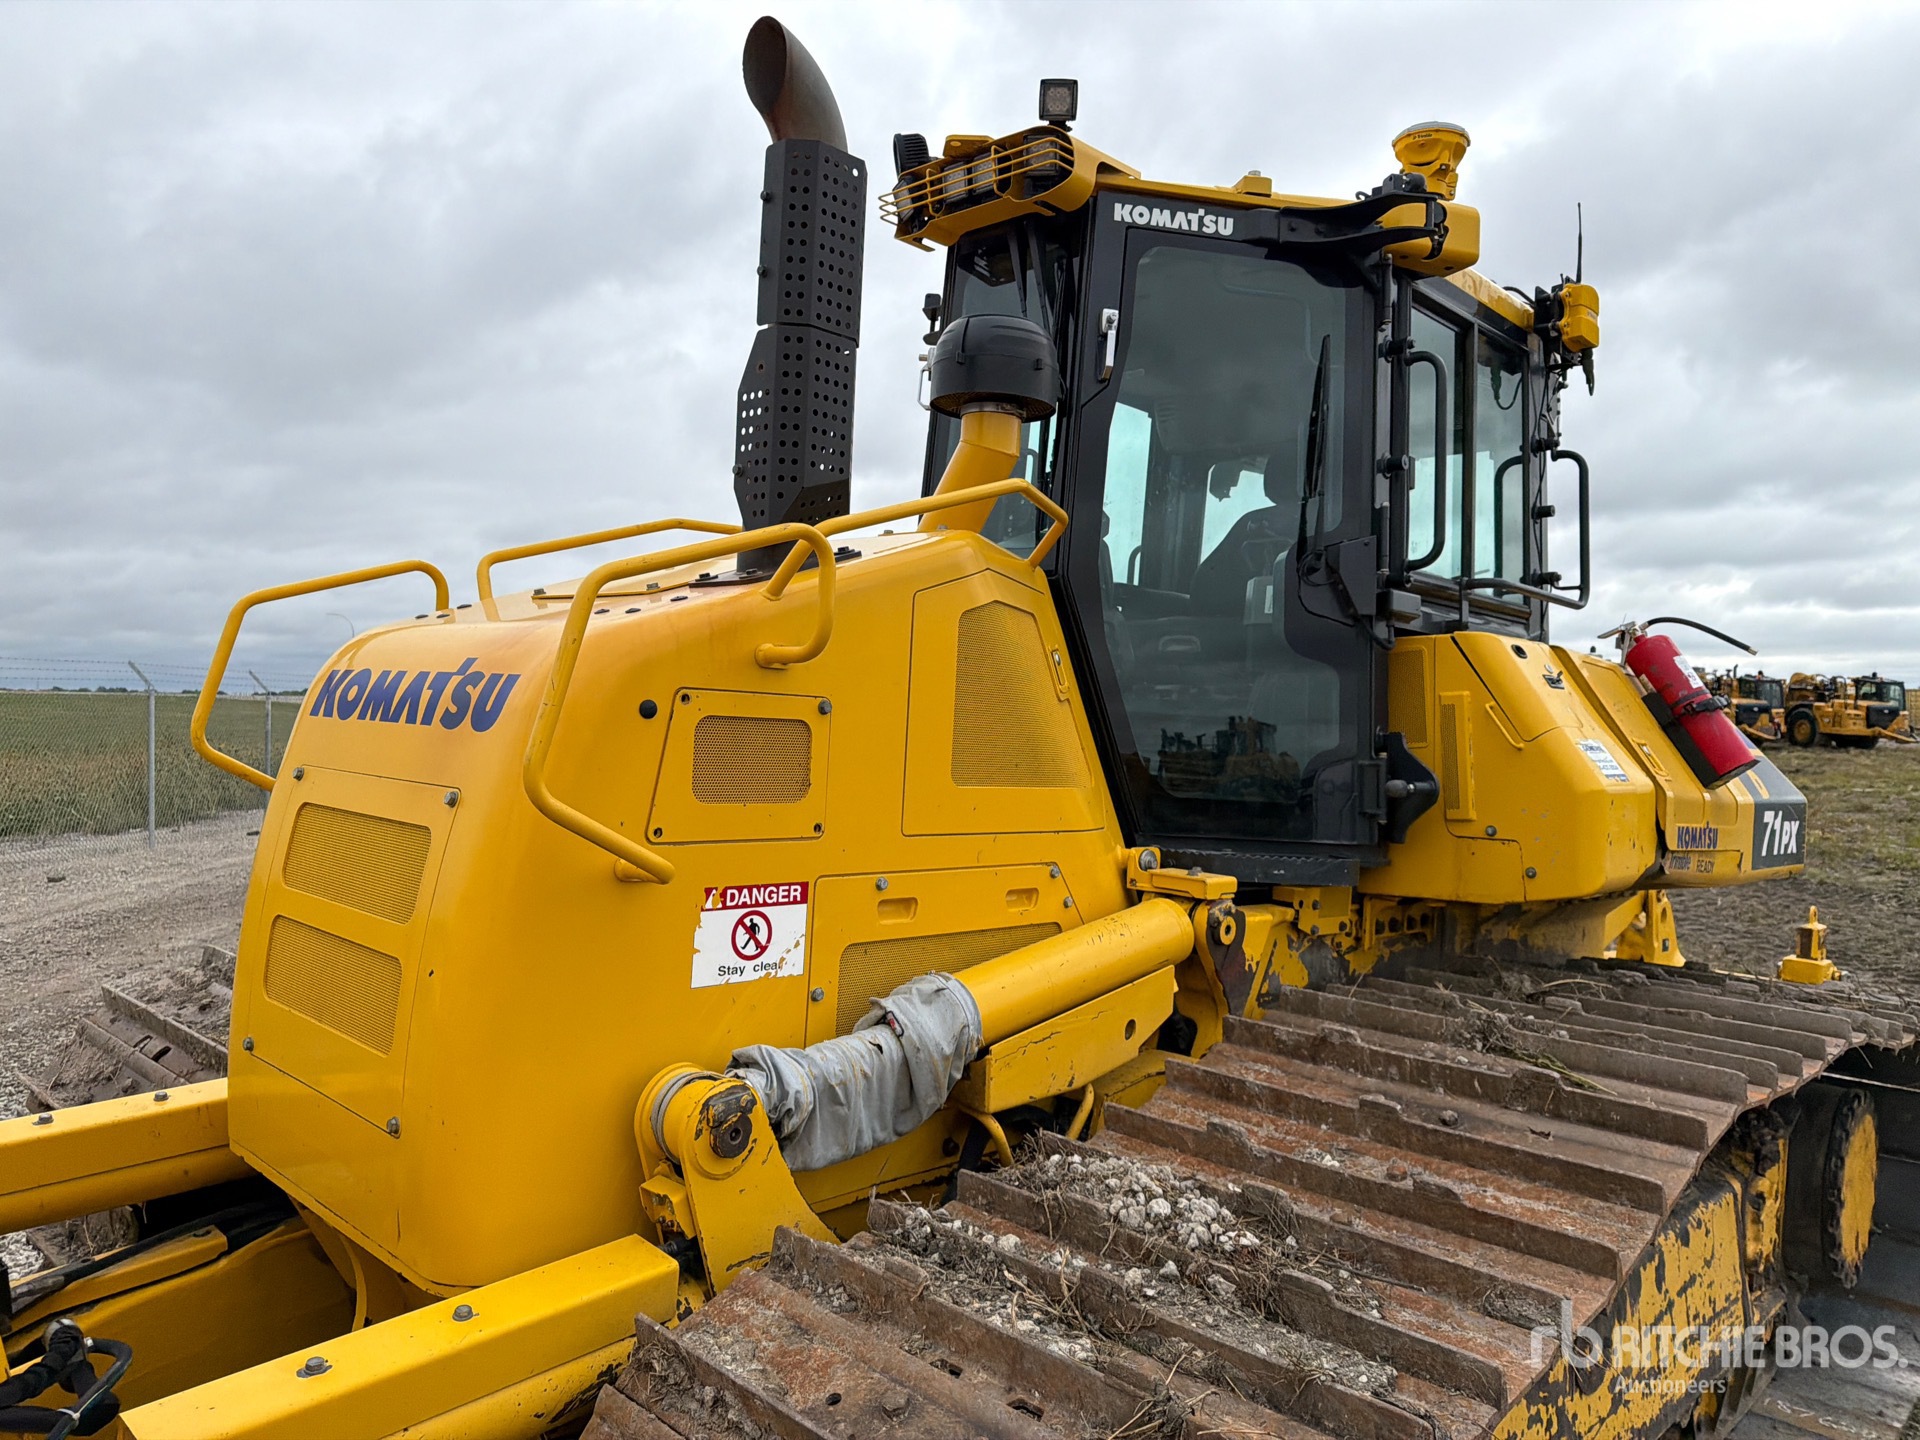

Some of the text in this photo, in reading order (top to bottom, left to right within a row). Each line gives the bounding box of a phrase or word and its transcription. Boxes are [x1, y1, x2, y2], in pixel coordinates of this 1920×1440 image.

[1113, 202, 1234, 236] KOMATSU
[309, 657, 521, 733] KOMATSU
[1677, 820, 1719, 849] KOMATSU
[1761, 810, 1800, 857] 71PX
[1696, 859, 1716, 874] READY
[725, 885, 802, 907] DANGER
[717, 964, 746, 977] Stay
